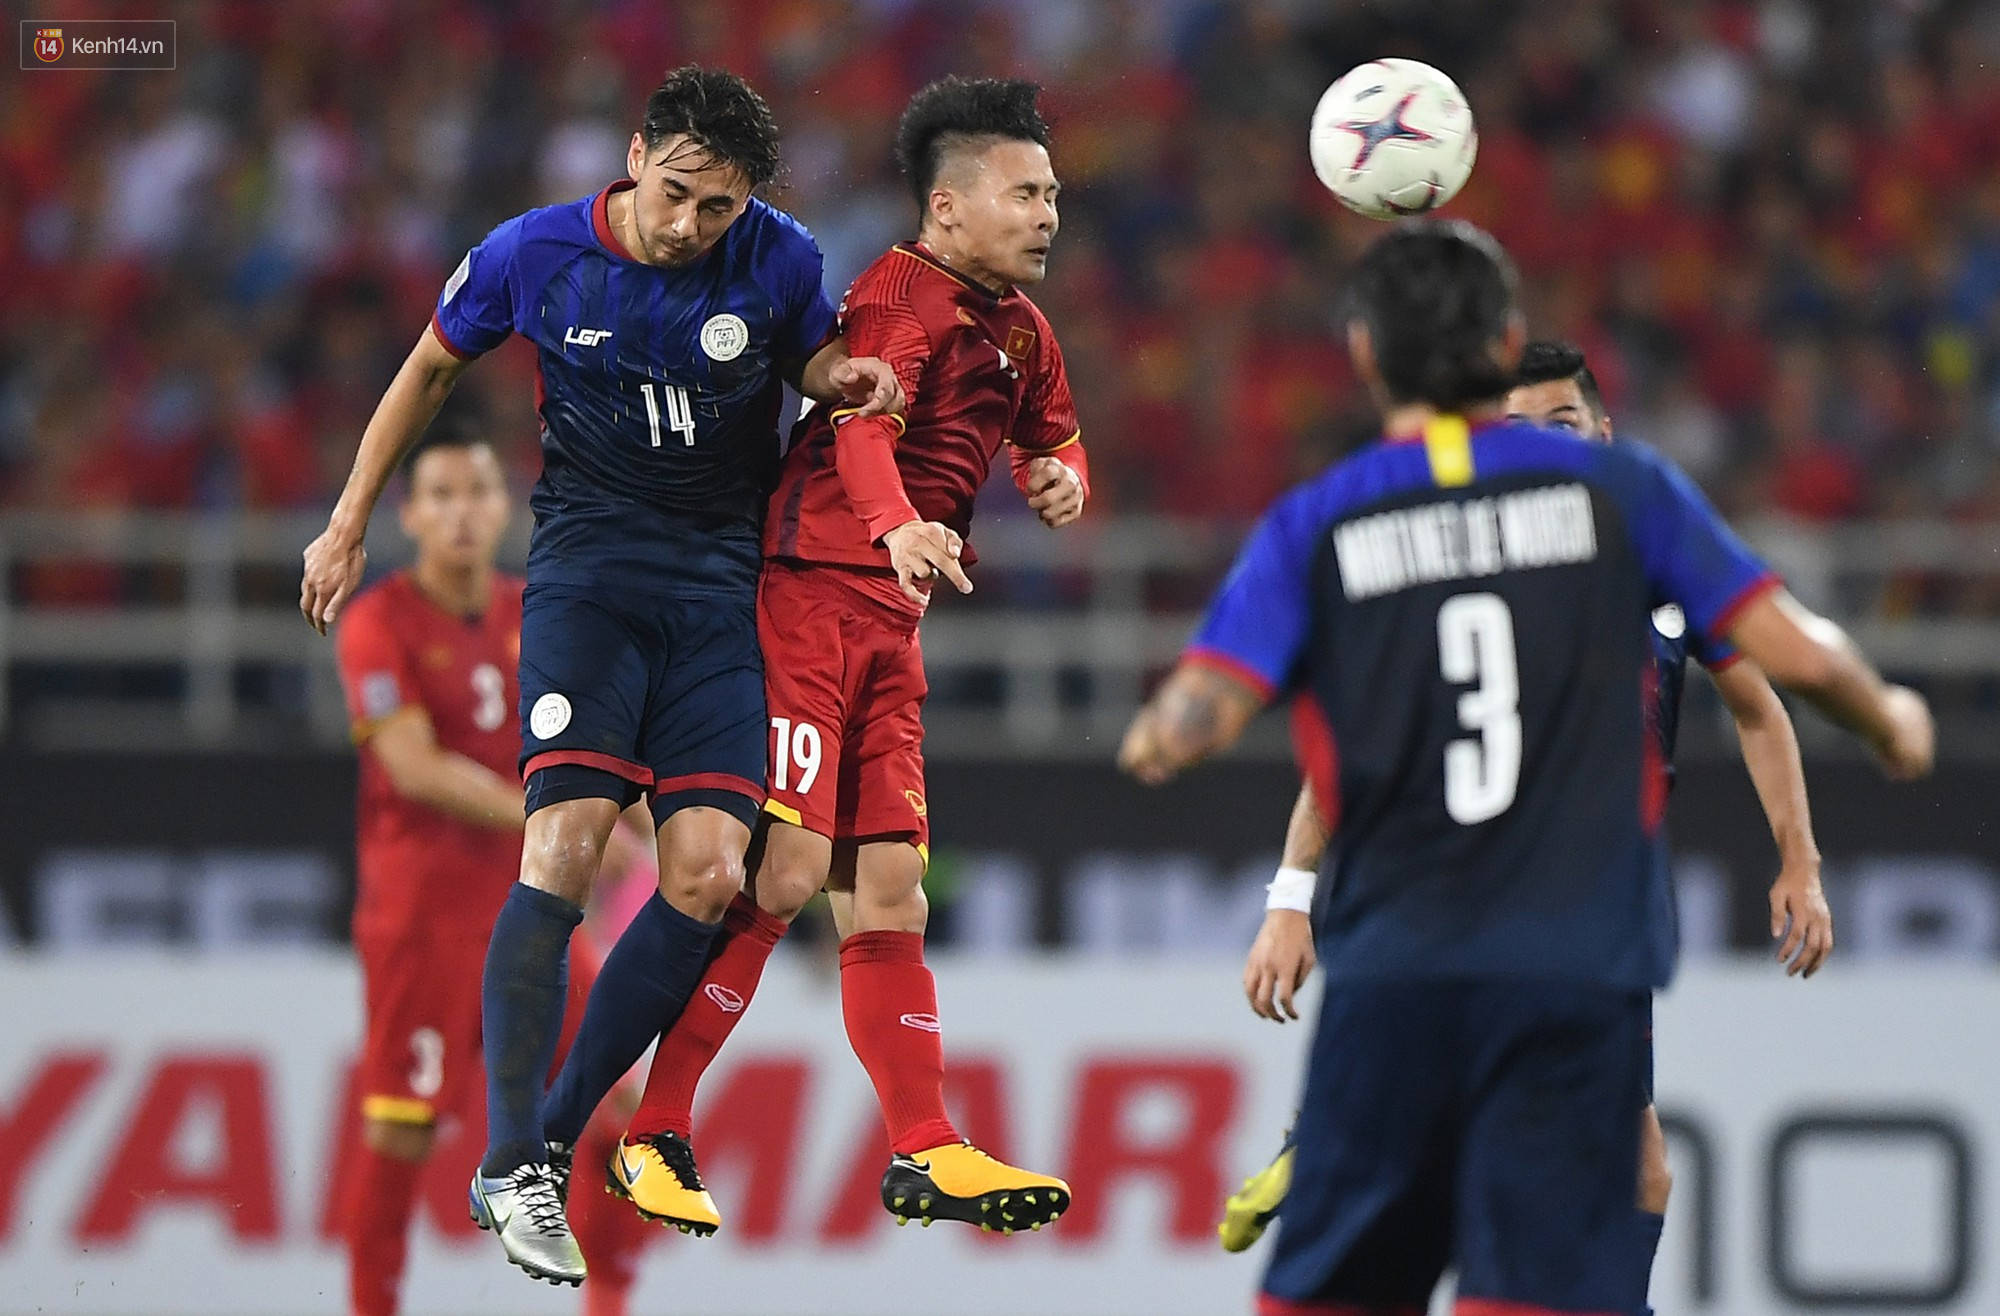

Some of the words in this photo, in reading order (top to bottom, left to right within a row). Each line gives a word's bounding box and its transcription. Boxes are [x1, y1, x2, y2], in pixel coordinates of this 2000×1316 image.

[640, 384, 695, 447] 14
[471, 663, 507, 732] 3
[1437, 592, 1523, 826] 3
[771, 717, 822, 794] 19
[408, 1027, 444, 1098] 3
